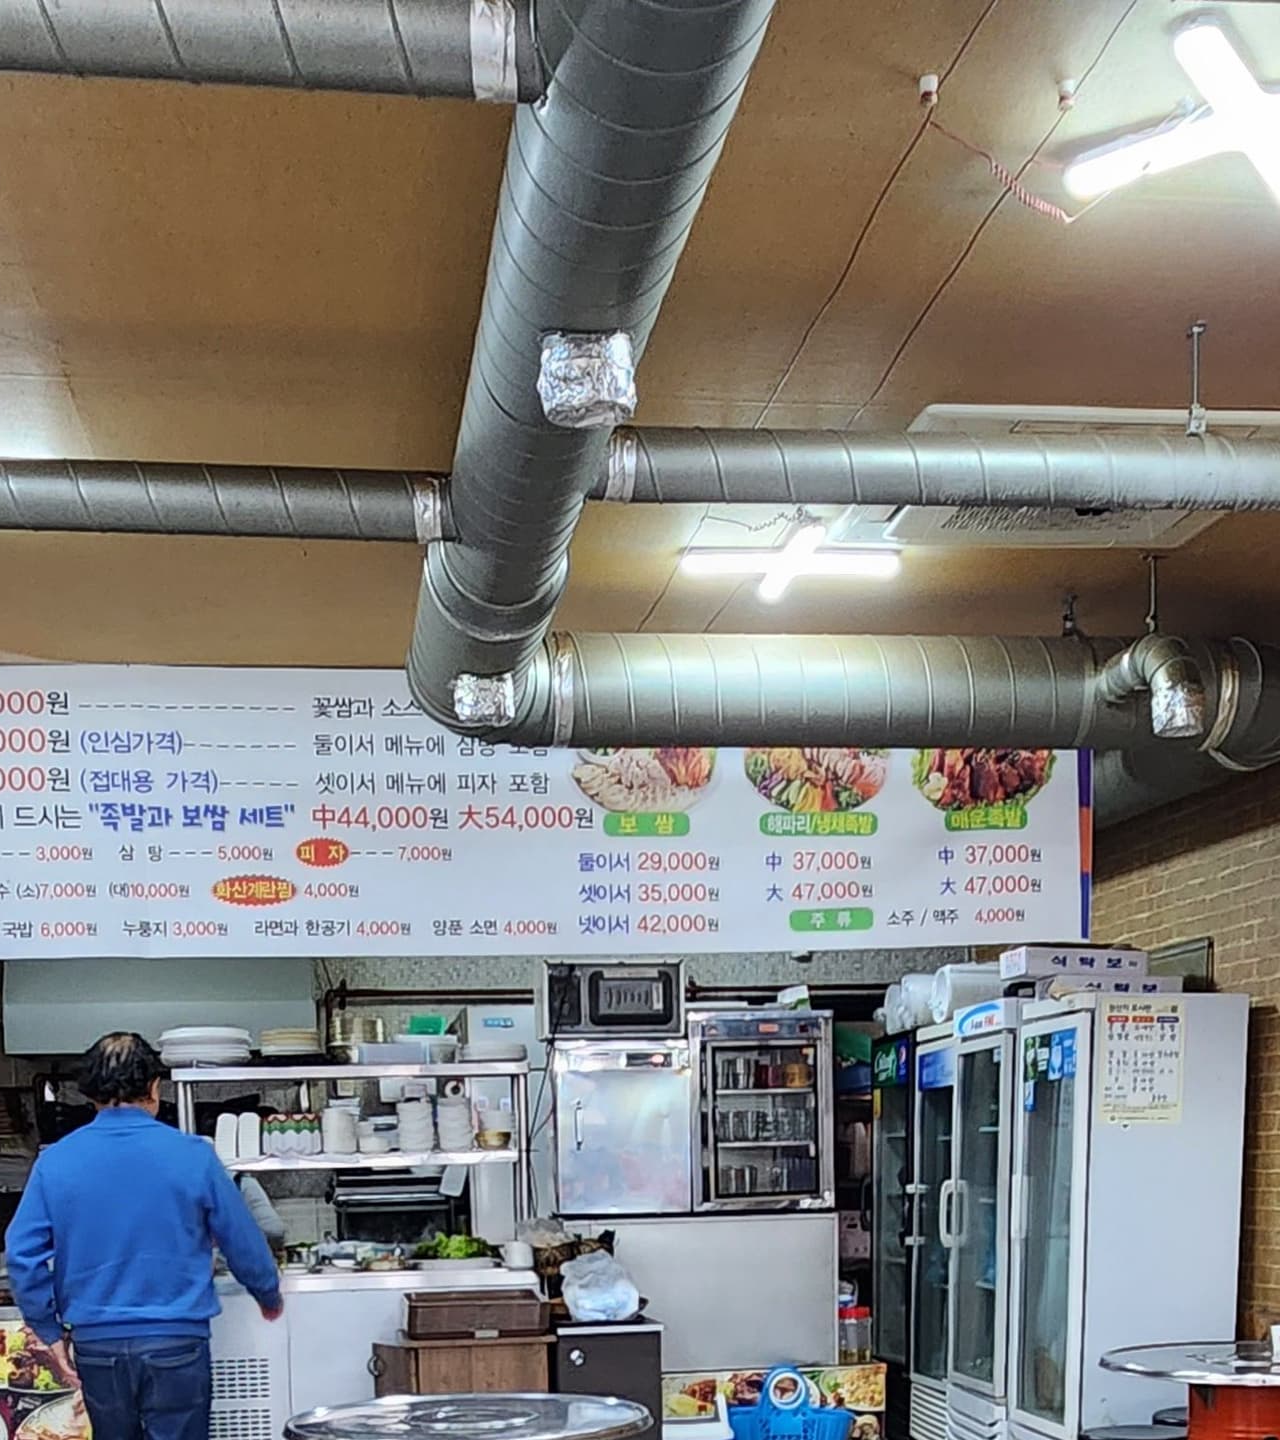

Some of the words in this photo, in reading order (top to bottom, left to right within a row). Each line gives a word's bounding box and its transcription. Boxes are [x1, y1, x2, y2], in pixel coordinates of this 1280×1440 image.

[312, 697, 374, 719] 꽃쌈과
[79, 730, 183, 756] (인심가격)
[313, 734, 374, 757] 둘이서
[384, 734, 445, 758] 메뉴에
[80, 769, 154, 794] (접대용
[166, 769, 218, 794] 가격)
[315, 773, 375, 795] 셋이서
[386, 773, 446, 795] 메뉴에
[457, 773, 497, 795] 피자
[508, 772, 550, 795] 포함
[14, 805, 82, 830] 드시는
[182, 804, 229, 832] 보쌈
[35, 846, 93, 862] 3,000원
[218, 846, 273, 861] 5,000원
[398, 846, 453, 862] 7,000원
[578, 852, 630, 872] 둘이서
[637, 852, 720, 872] 29,000원
[793, 852, 871, 871] 37,000원
[965, 845, 1041, 864] 37,000원
[304, 884, 360, 898] 4,000원
[578, 883, 630, 904] 셋이서
[638, 883, 720, 903] 35,000원
[792, 882, 873, 901] 47,000원
[964, 876, 1041, 894] 47,000원
[578, 915, 630, 935] 넷이서
[637, 914, 719, 933] 42,000원
[887, 910, 914, 927] 소주
[932, 908, 959, 926] 맥주
[974, 908, 1025, 923] 4,000원
[2, 922, 33, 938] 국밥
[40, 921, 97, 937] 6,000원
[122, 921, 167, 937] 누룽지
[172, 922, 228, 937] 3,000원
[255, 920, 298, 937] 라면과
[305, 920, 351, 937] 한공기
[356, 921, 411, 936] 4,000원
[469, 920, 497, 936] 소면
[503, 921, 557, 935] 4,000원
